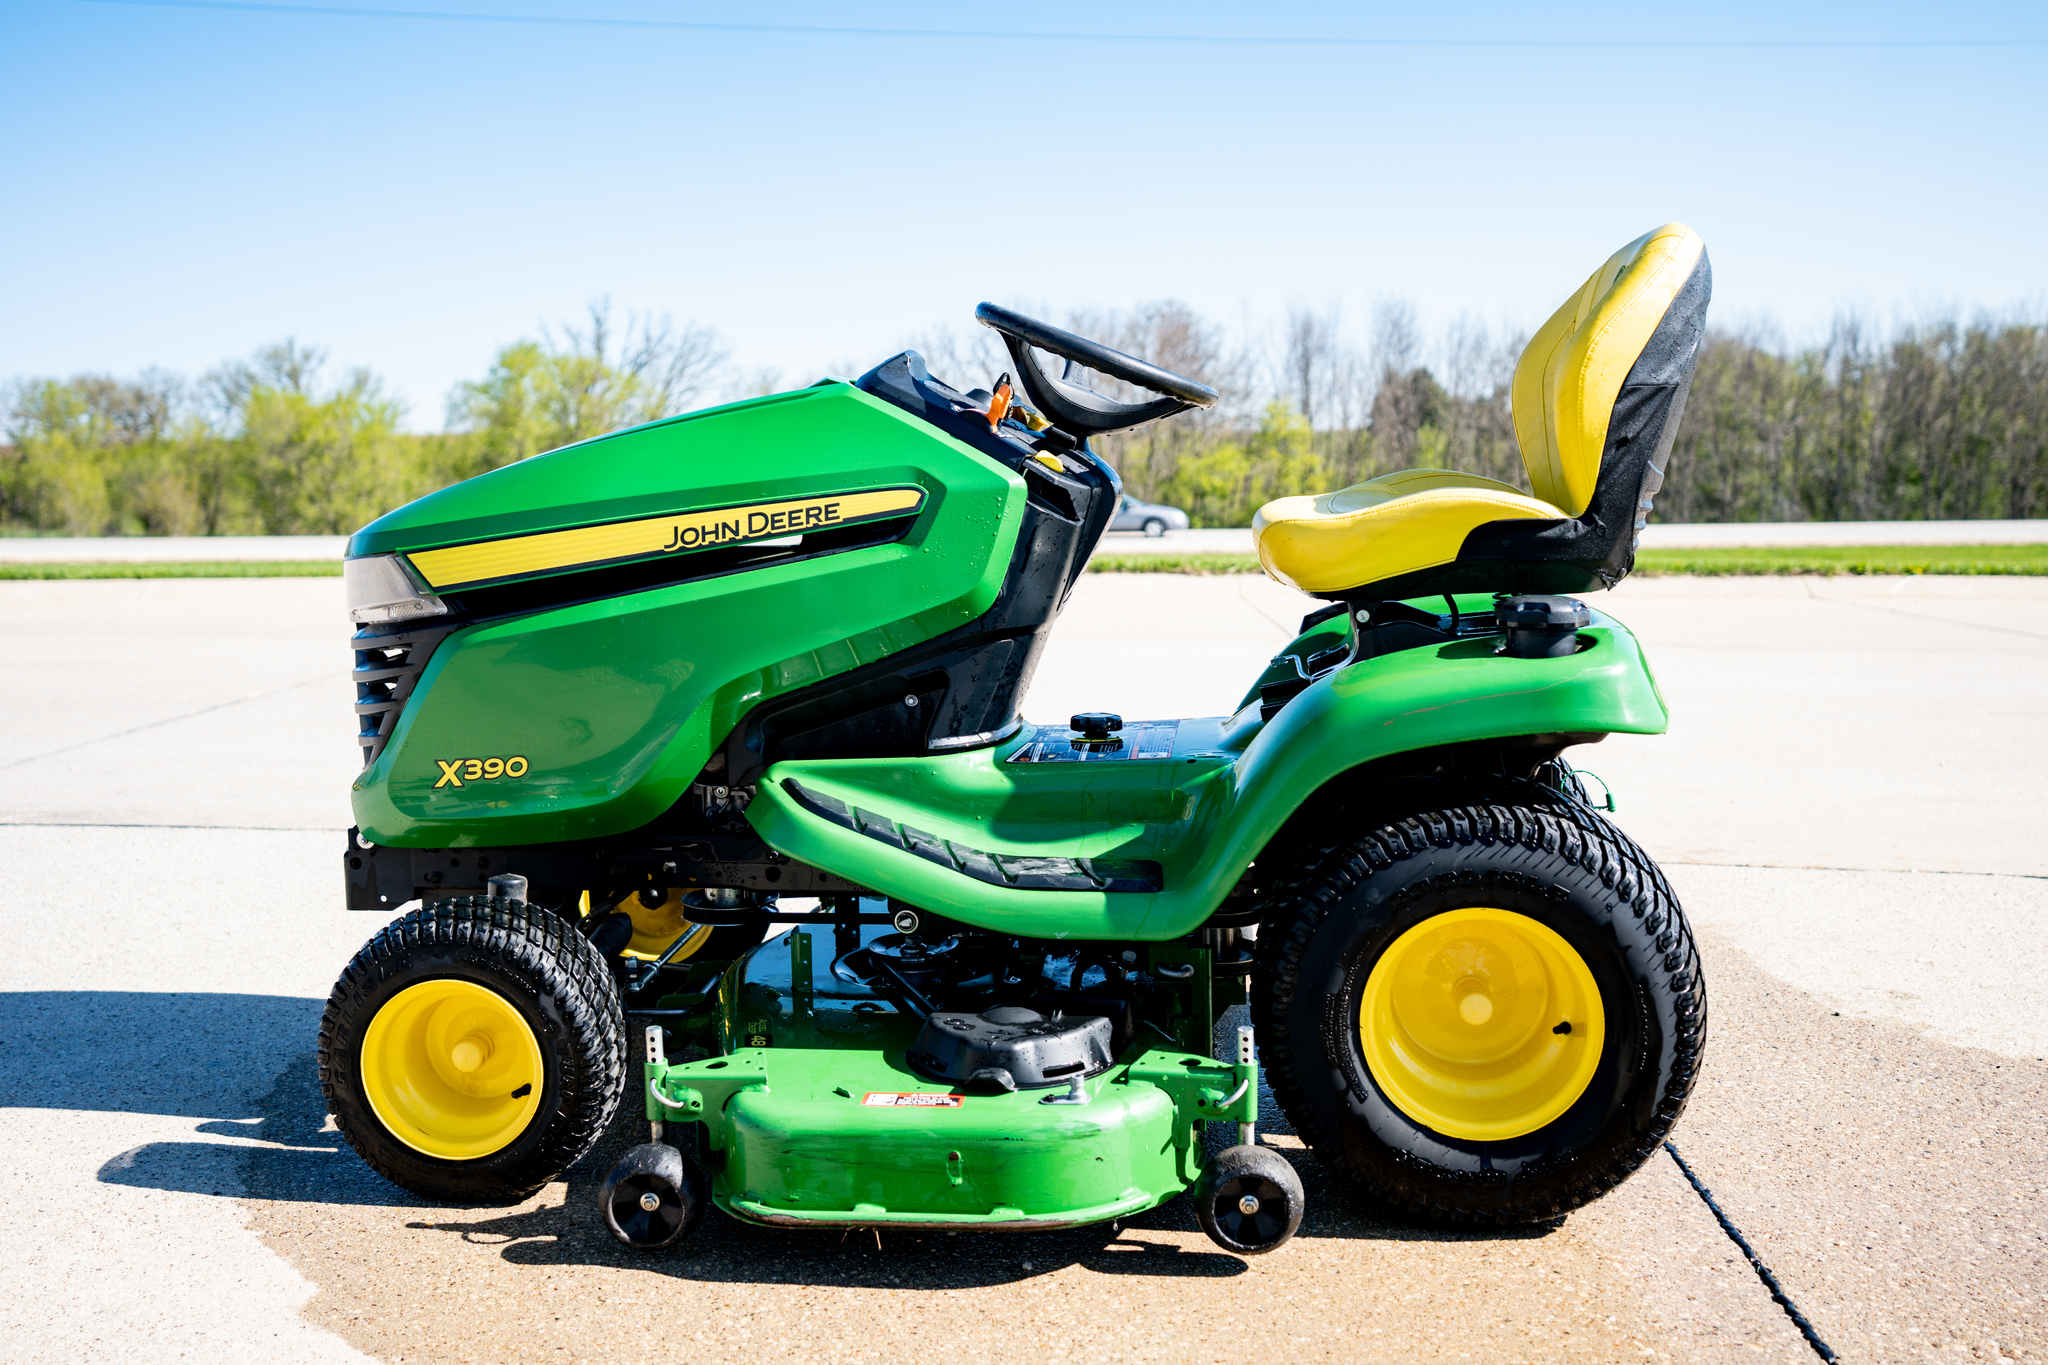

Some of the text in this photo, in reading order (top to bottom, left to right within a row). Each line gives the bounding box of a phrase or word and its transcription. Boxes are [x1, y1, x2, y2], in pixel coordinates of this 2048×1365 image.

[663, 502, 842, 551] JOHN DEERE
[430, 754, 529, 789] X390
[332, 951, 412, 1092] CARLISLE
